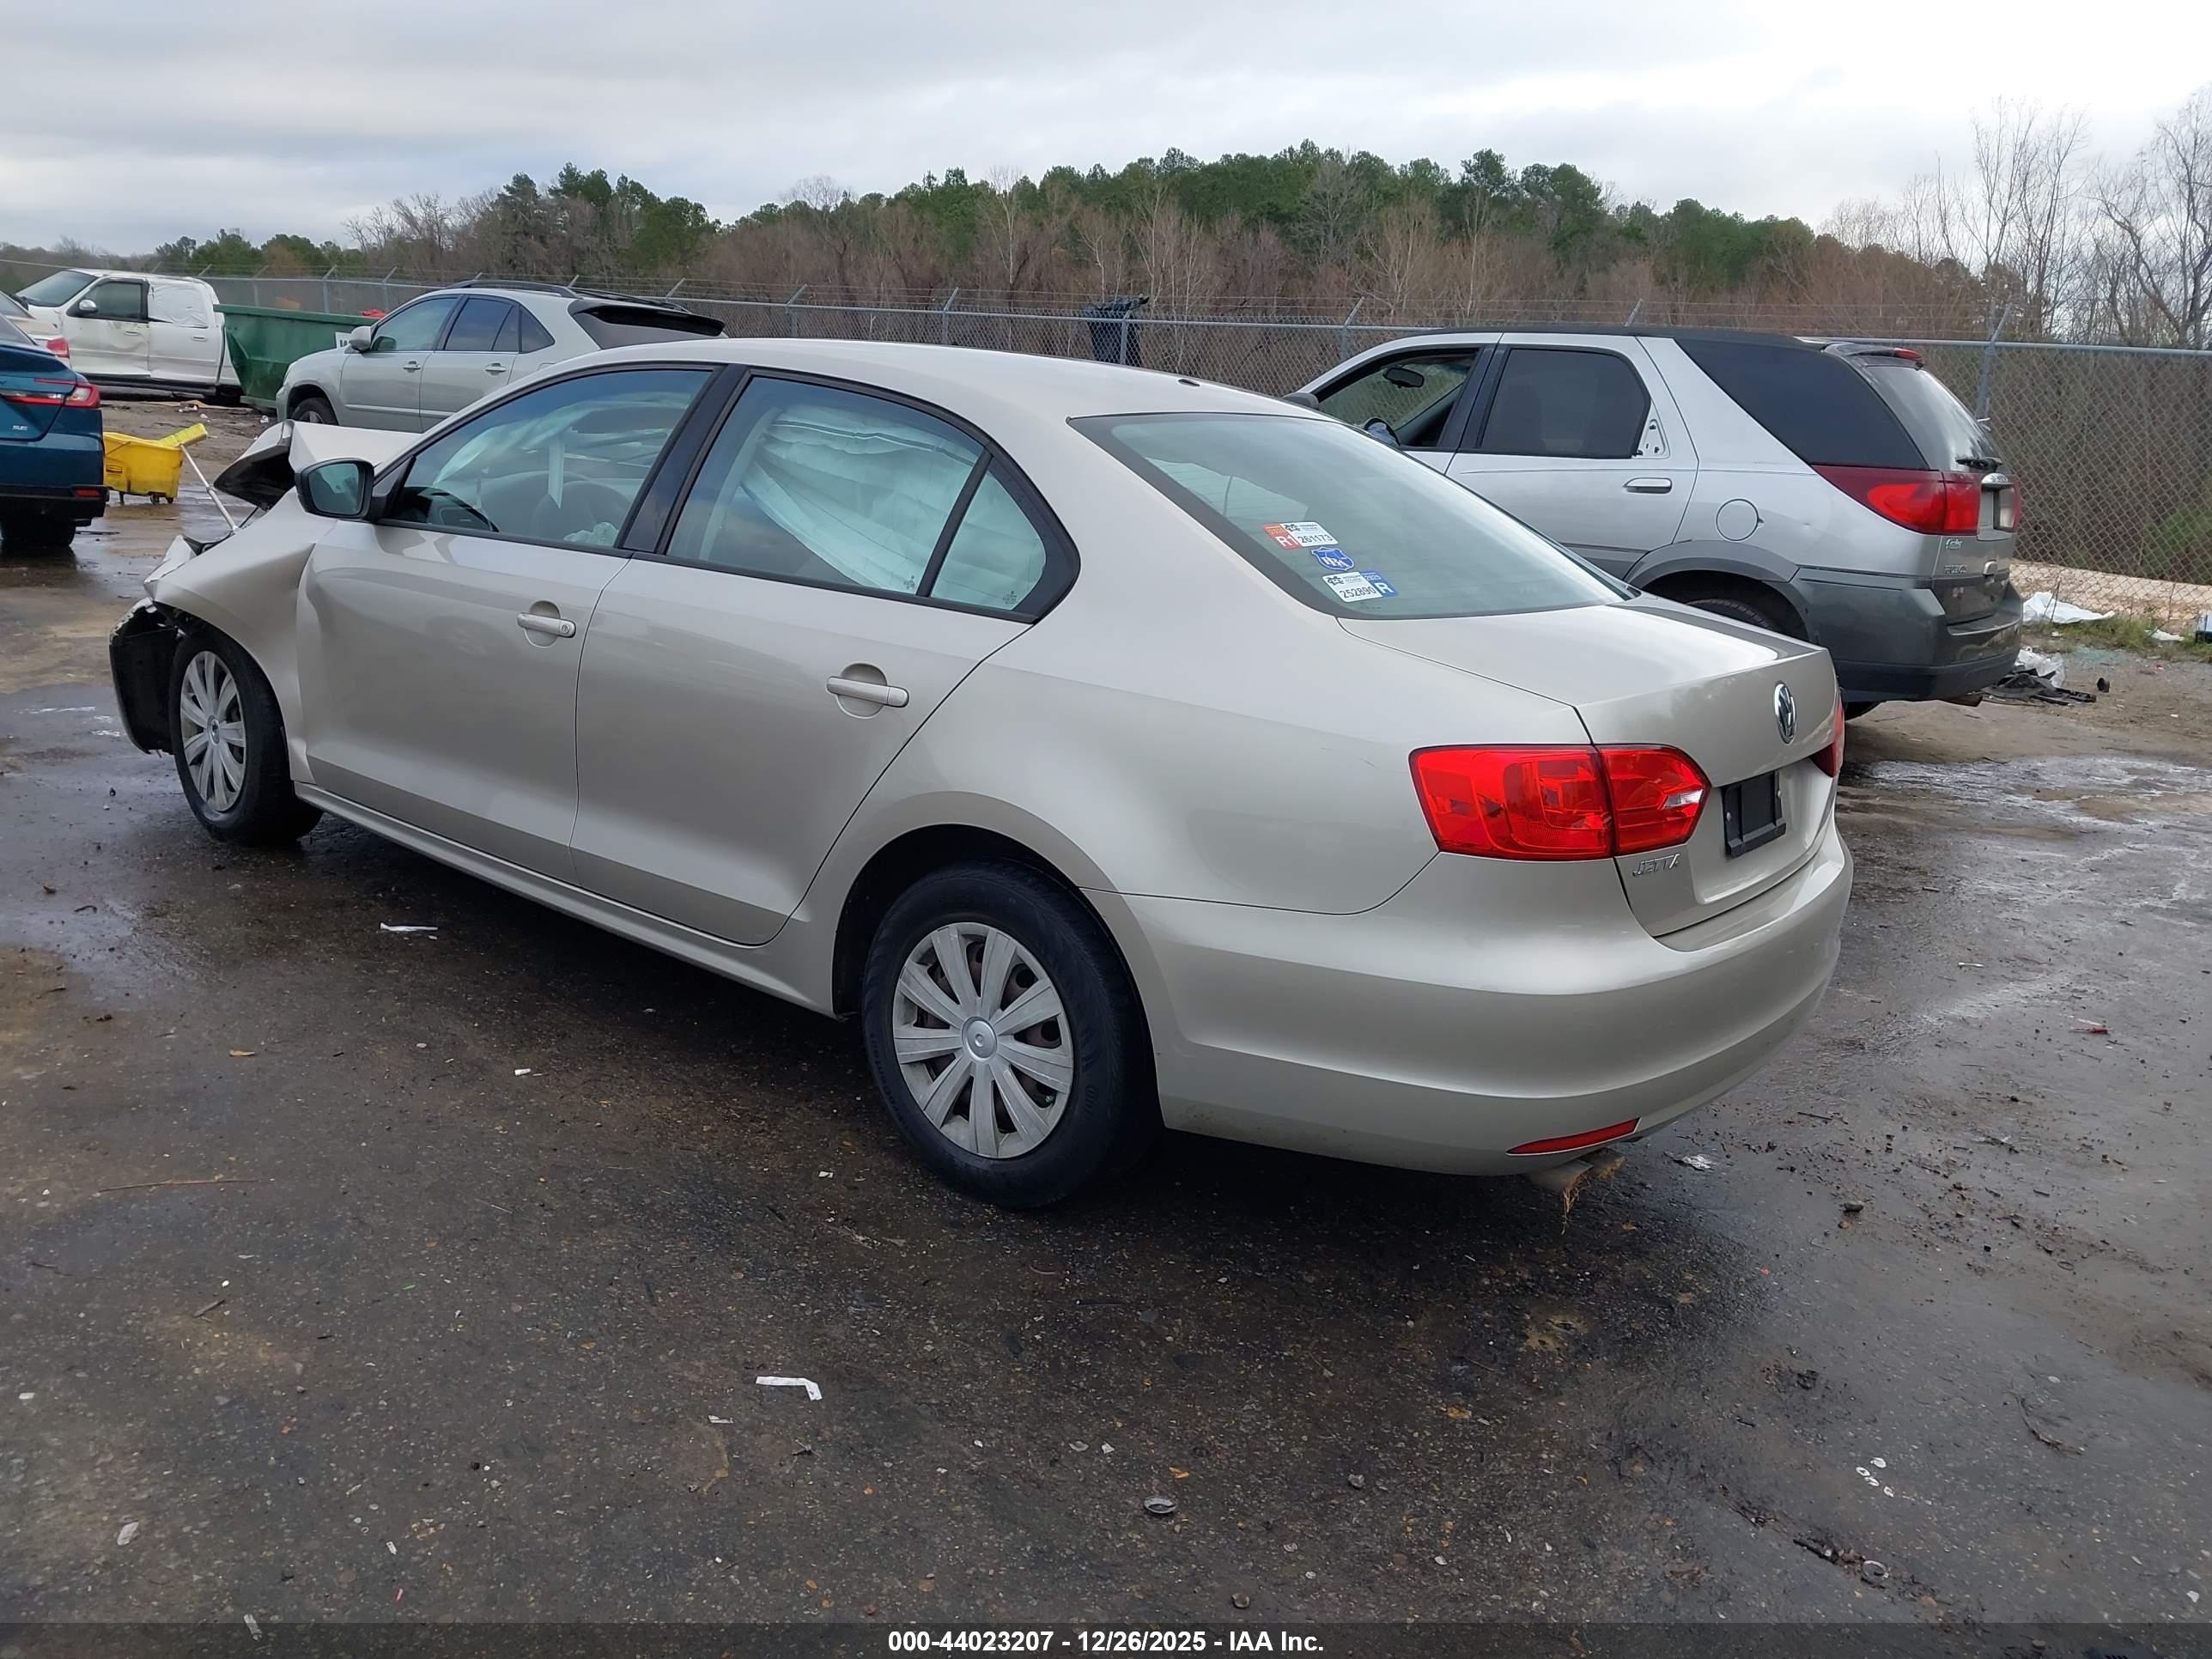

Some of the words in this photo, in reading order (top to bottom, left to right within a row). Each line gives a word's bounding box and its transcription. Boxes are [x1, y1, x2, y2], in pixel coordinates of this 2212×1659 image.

[1275, 535, 1298, 547] R1
[1297, 534, 1334, 544] 261173
[1339, 586, 1376, 599] 252890
[1374, 583, 1395, 593] R
[1632, 854, 1680, 876] JETTA
